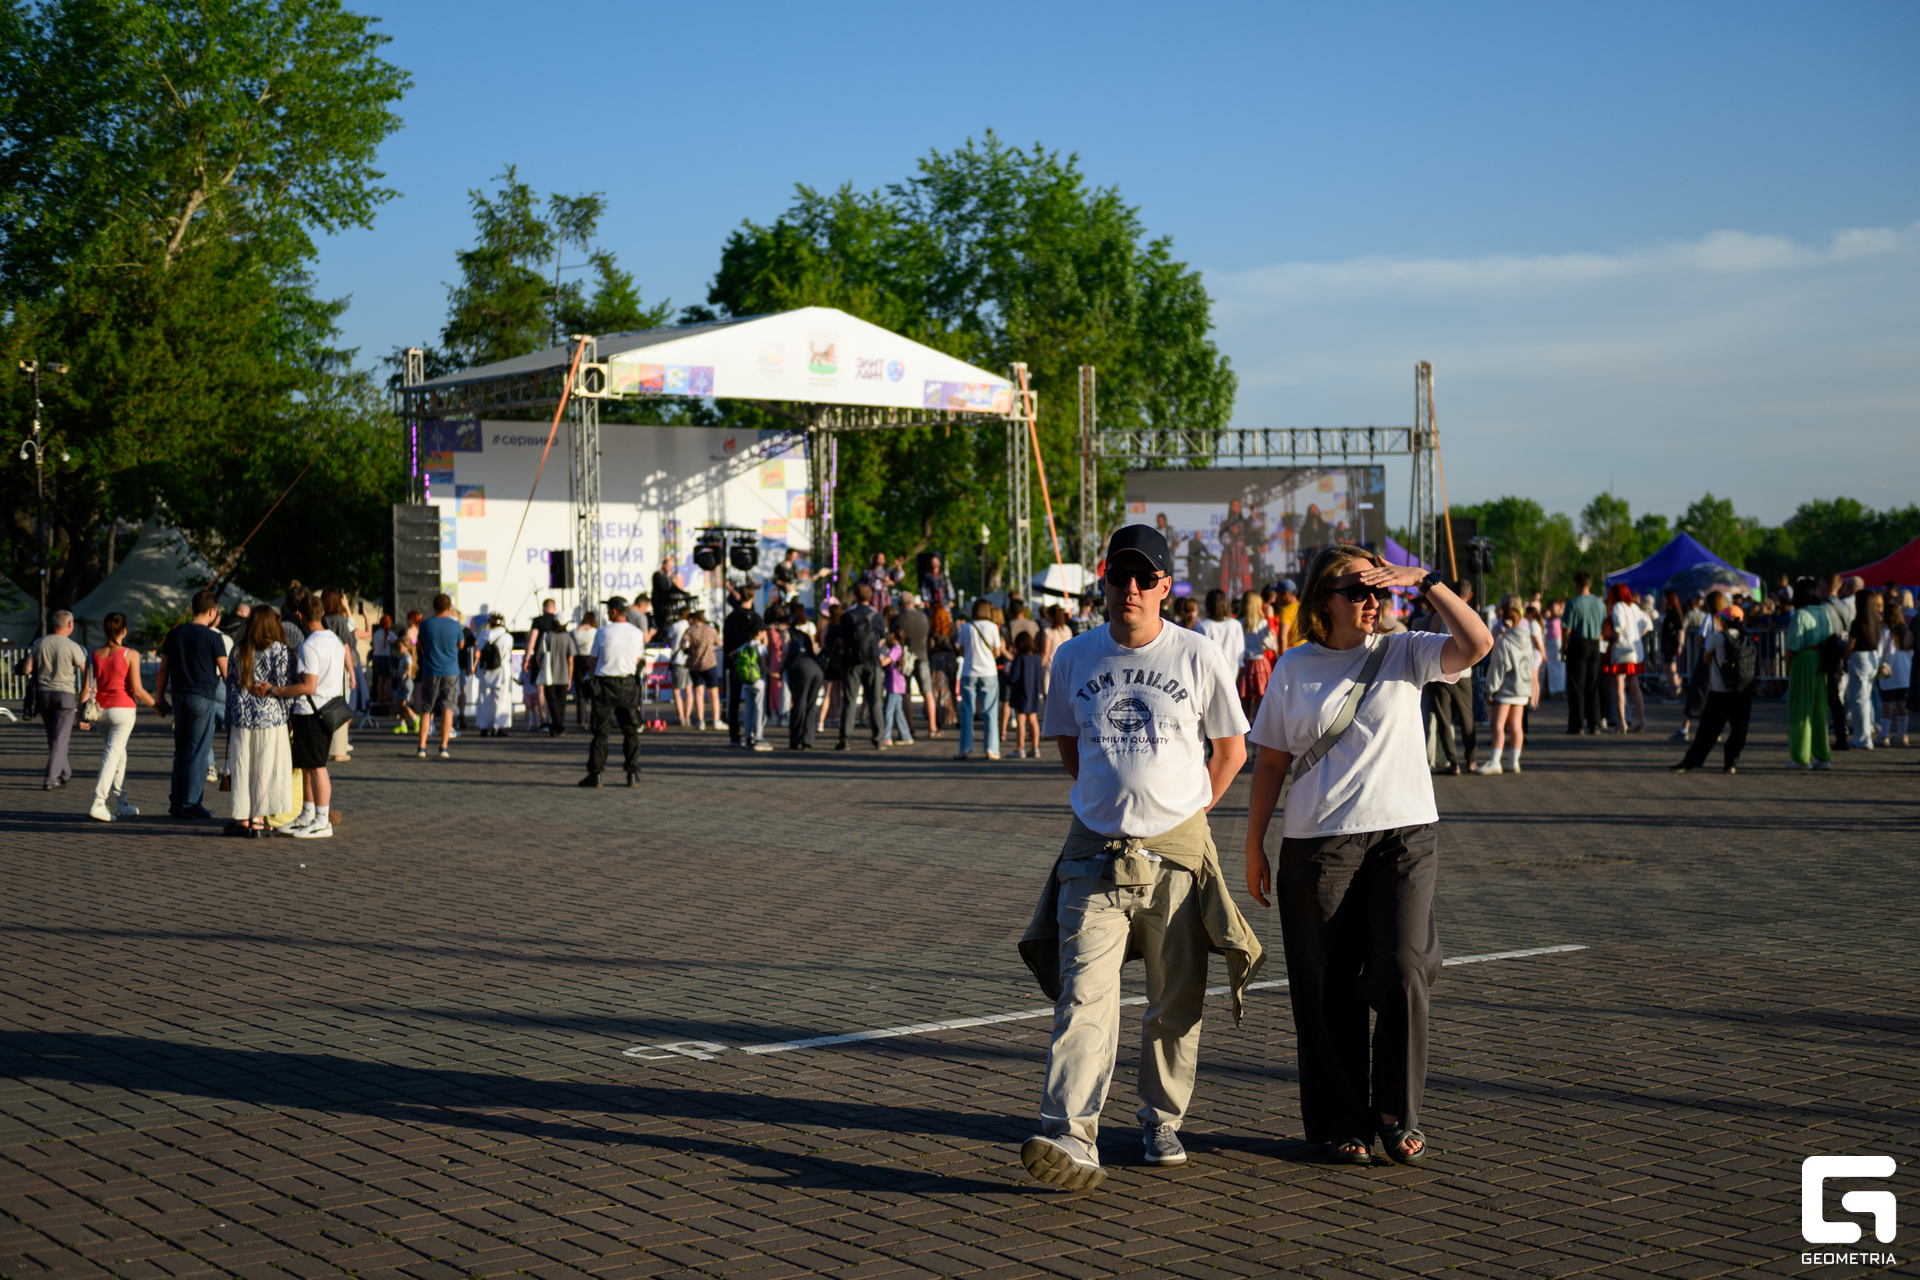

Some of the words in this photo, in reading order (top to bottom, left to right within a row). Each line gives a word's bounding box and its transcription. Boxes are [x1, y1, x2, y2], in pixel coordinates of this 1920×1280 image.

[526, 547, 644, 564] РОНИЯ
[1076, 671, 1115, 701] TOM
[1123, 668, 1189, 703] TAILOR
[1158, 722, 1182, 731] TRMK
[1130, 736, 1170, 745] QUALITY
